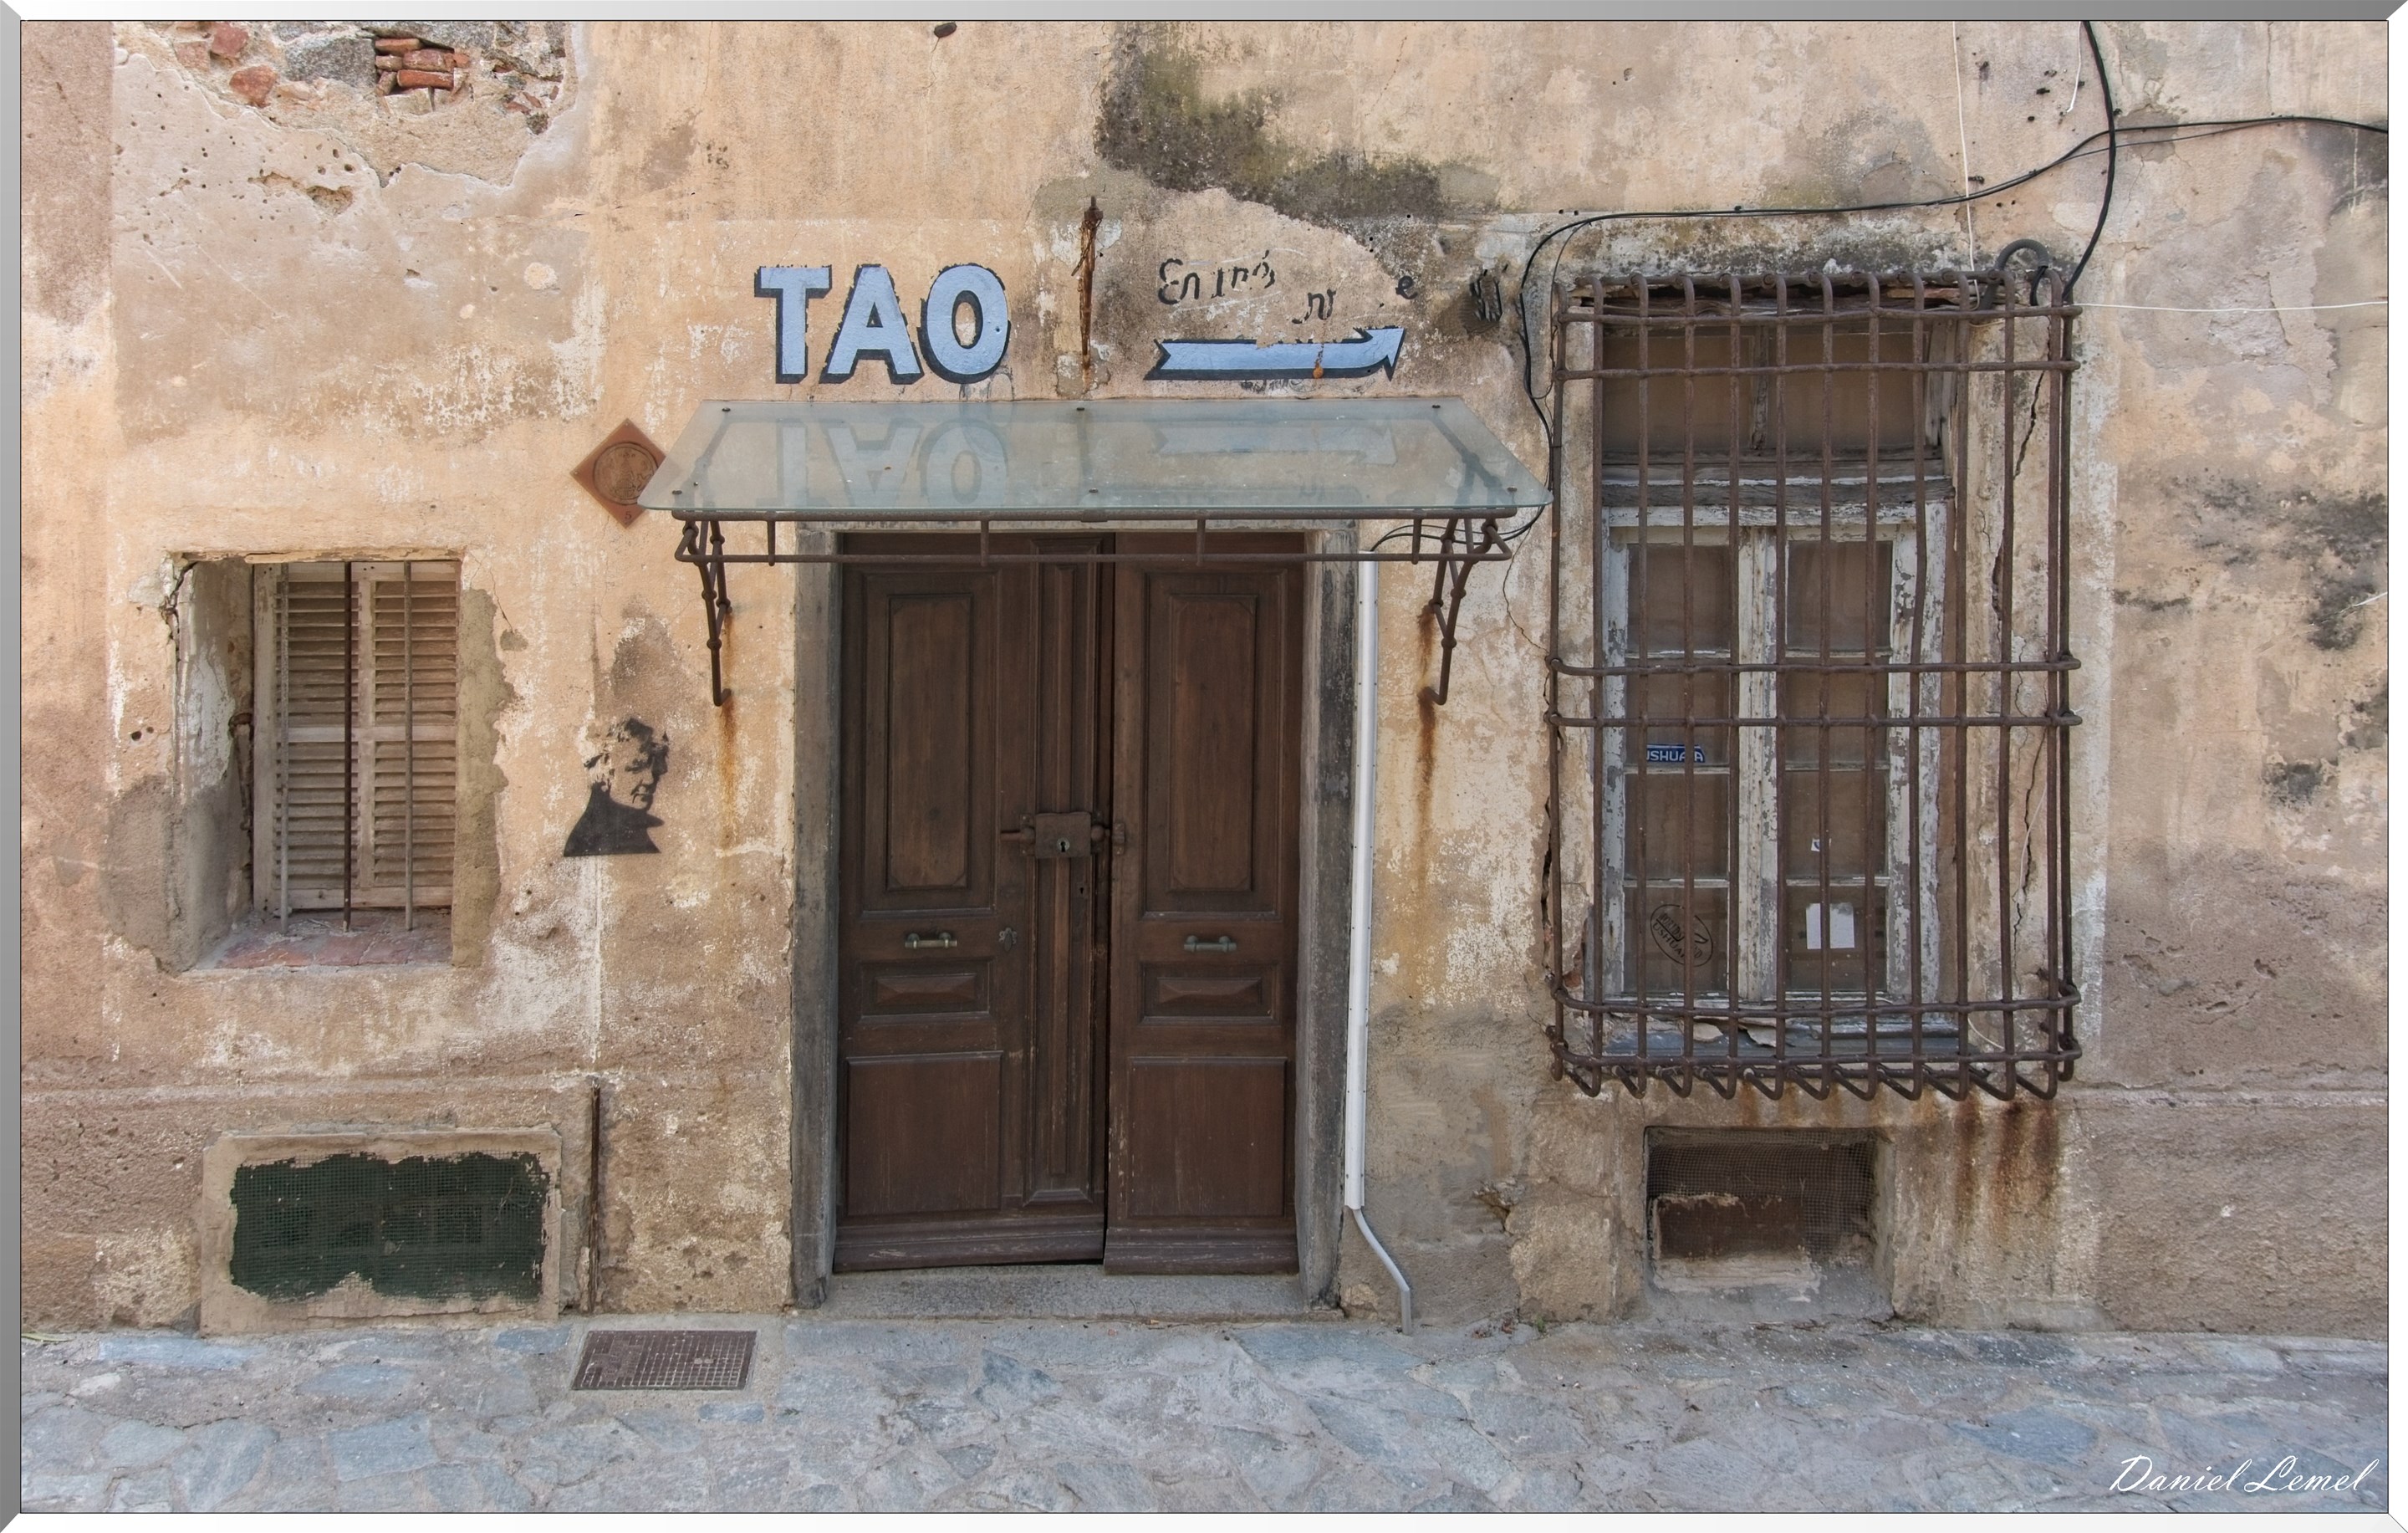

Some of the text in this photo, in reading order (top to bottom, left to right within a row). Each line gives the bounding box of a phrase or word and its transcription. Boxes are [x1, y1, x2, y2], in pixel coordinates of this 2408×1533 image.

[754, 263, 1011, 385] TAO
[625, 511, 632, 520] 5
[1646, 750, 1704, 762] SHUAA
